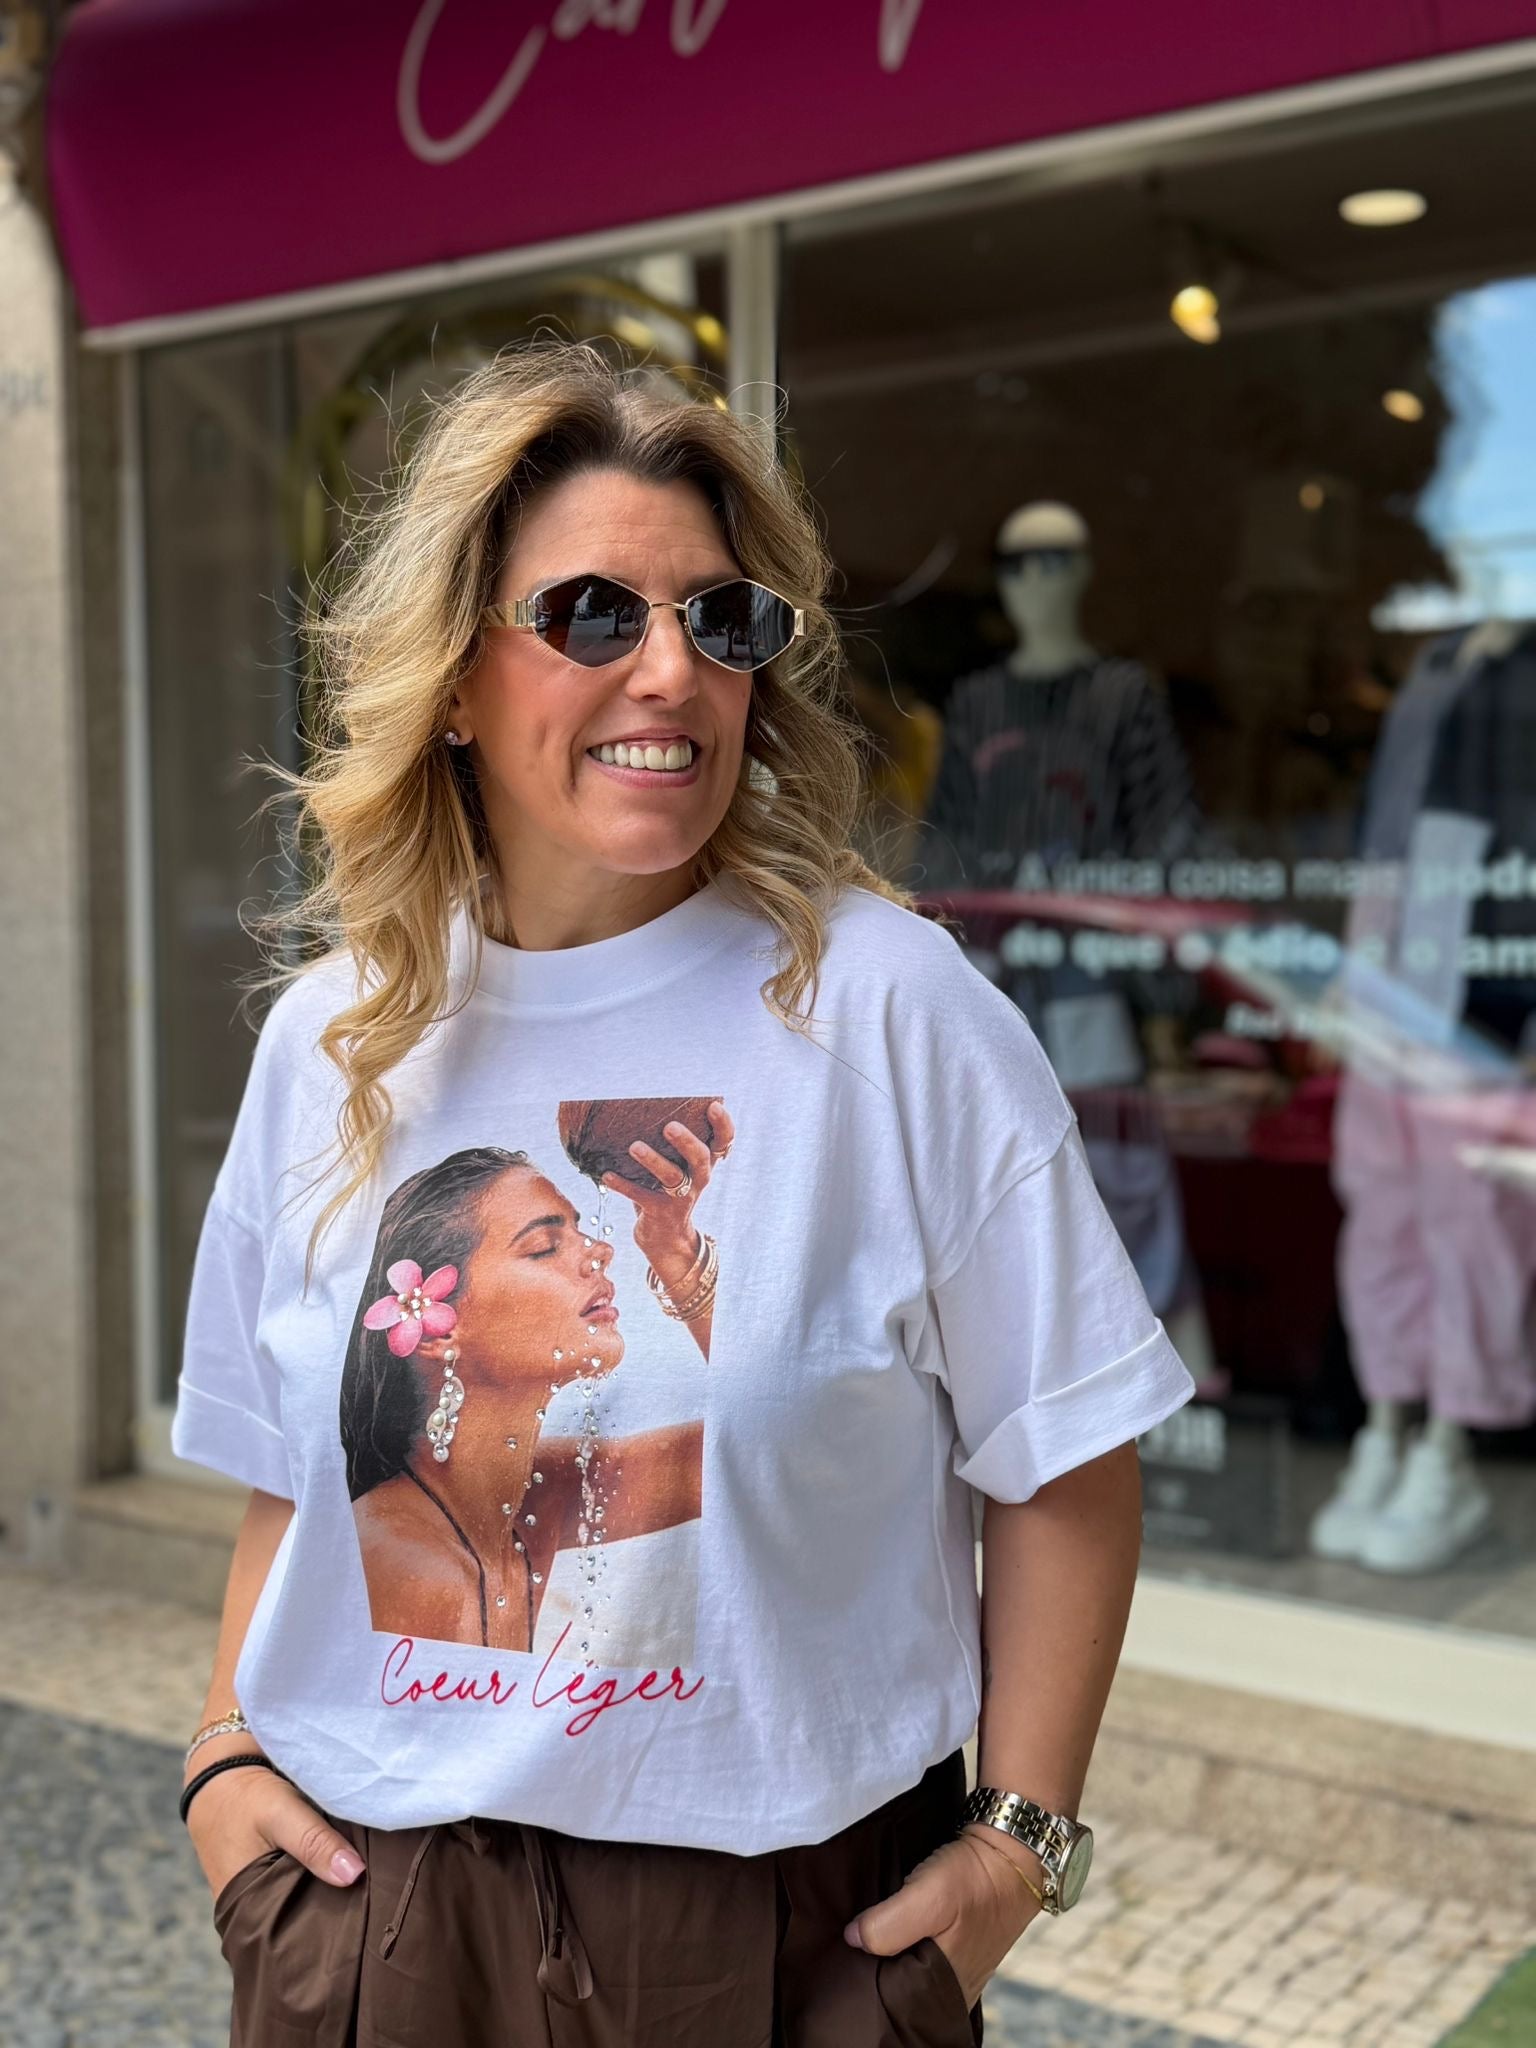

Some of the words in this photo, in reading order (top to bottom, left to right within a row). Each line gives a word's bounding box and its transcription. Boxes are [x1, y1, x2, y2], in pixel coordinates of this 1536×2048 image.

[1169, 854, 1283, 899] coisa
[1071, 928, 1167, 980] que
[381, 1637, 518, 1706] Coeur
